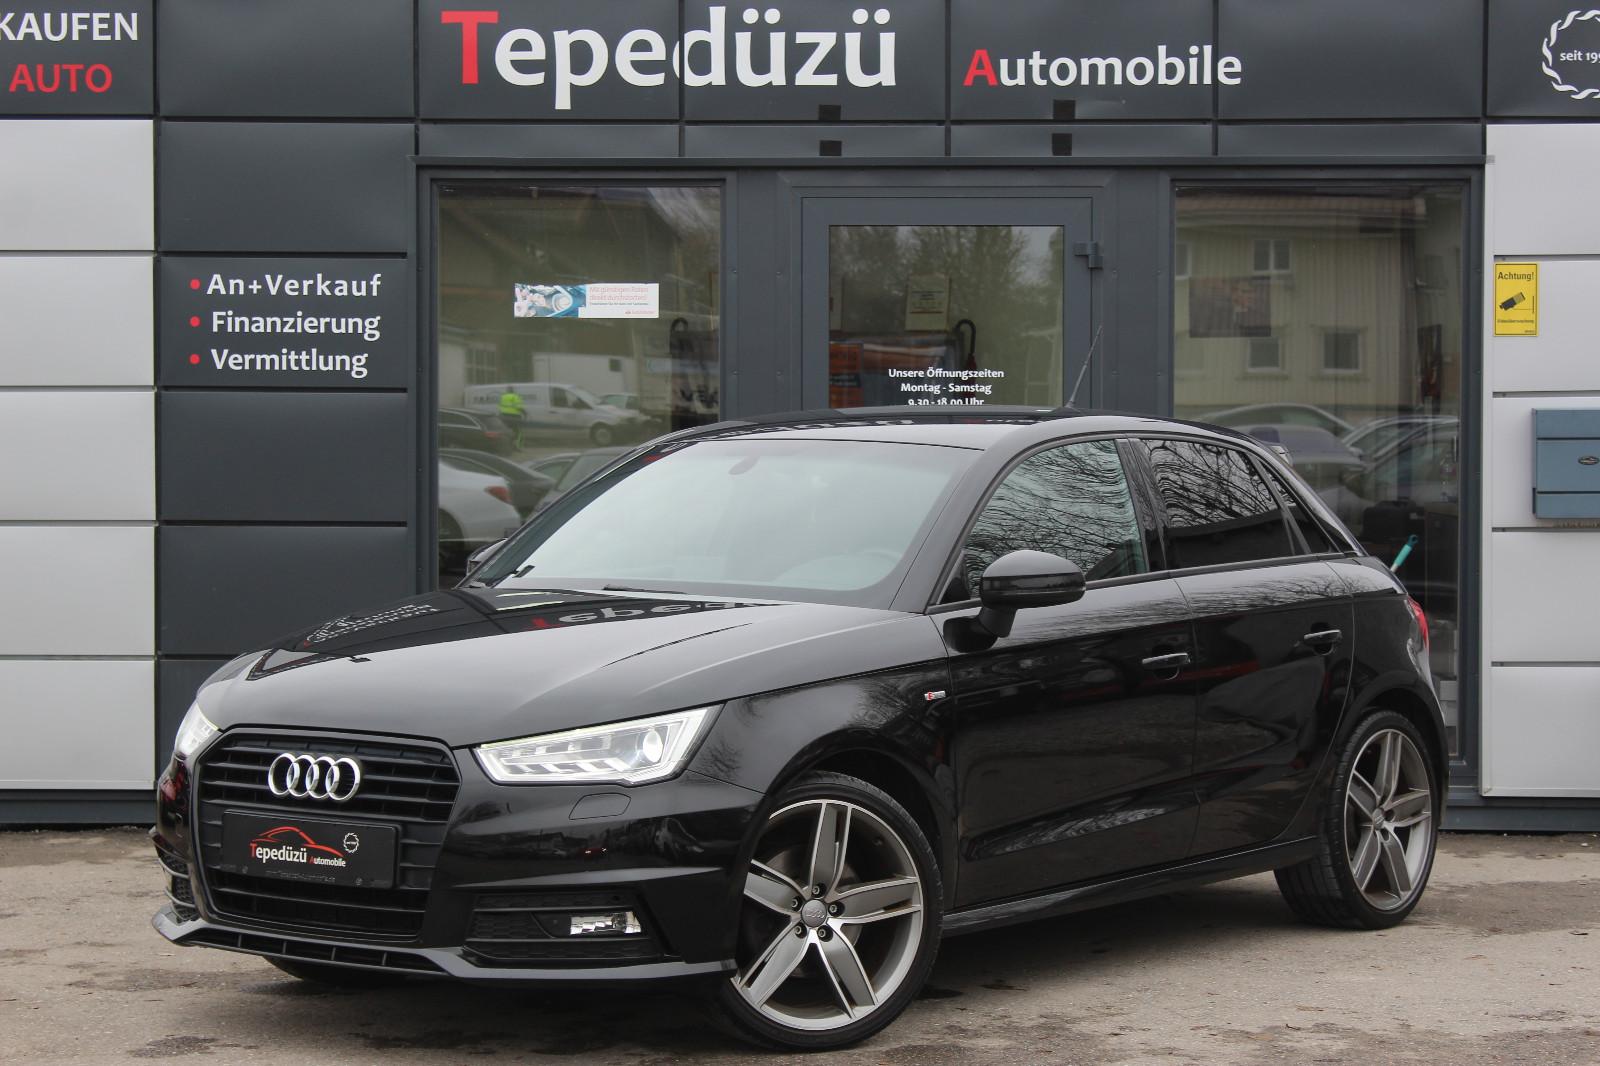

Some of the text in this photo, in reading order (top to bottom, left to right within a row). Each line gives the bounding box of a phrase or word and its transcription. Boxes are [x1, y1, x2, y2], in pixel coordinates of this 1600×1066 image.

[0, 12, 138, 41] KAUFEN
[440, 6, 1242, 110] Tepedüzü Automobile
[1560, 50, 1600, 64] seit 19
[9, 63, 112, 93] AUTO
[206, 273, 382, 297] An+Verkauf
[1498, 271, 1535, 282] Achtung!
[211, 310, 381, 342] Finanzierung
[211, 348, 368, 379] Vermittlung
[888, 367, 1004, 380] Unsere Öffnungszeiten
[900, 383, 941, 395] Montag
[948, 383, 992, 395] Samstag
[937, 397, 963, 405] 1800
[251, 843, 345, 867] Tepedüzü Automobile
